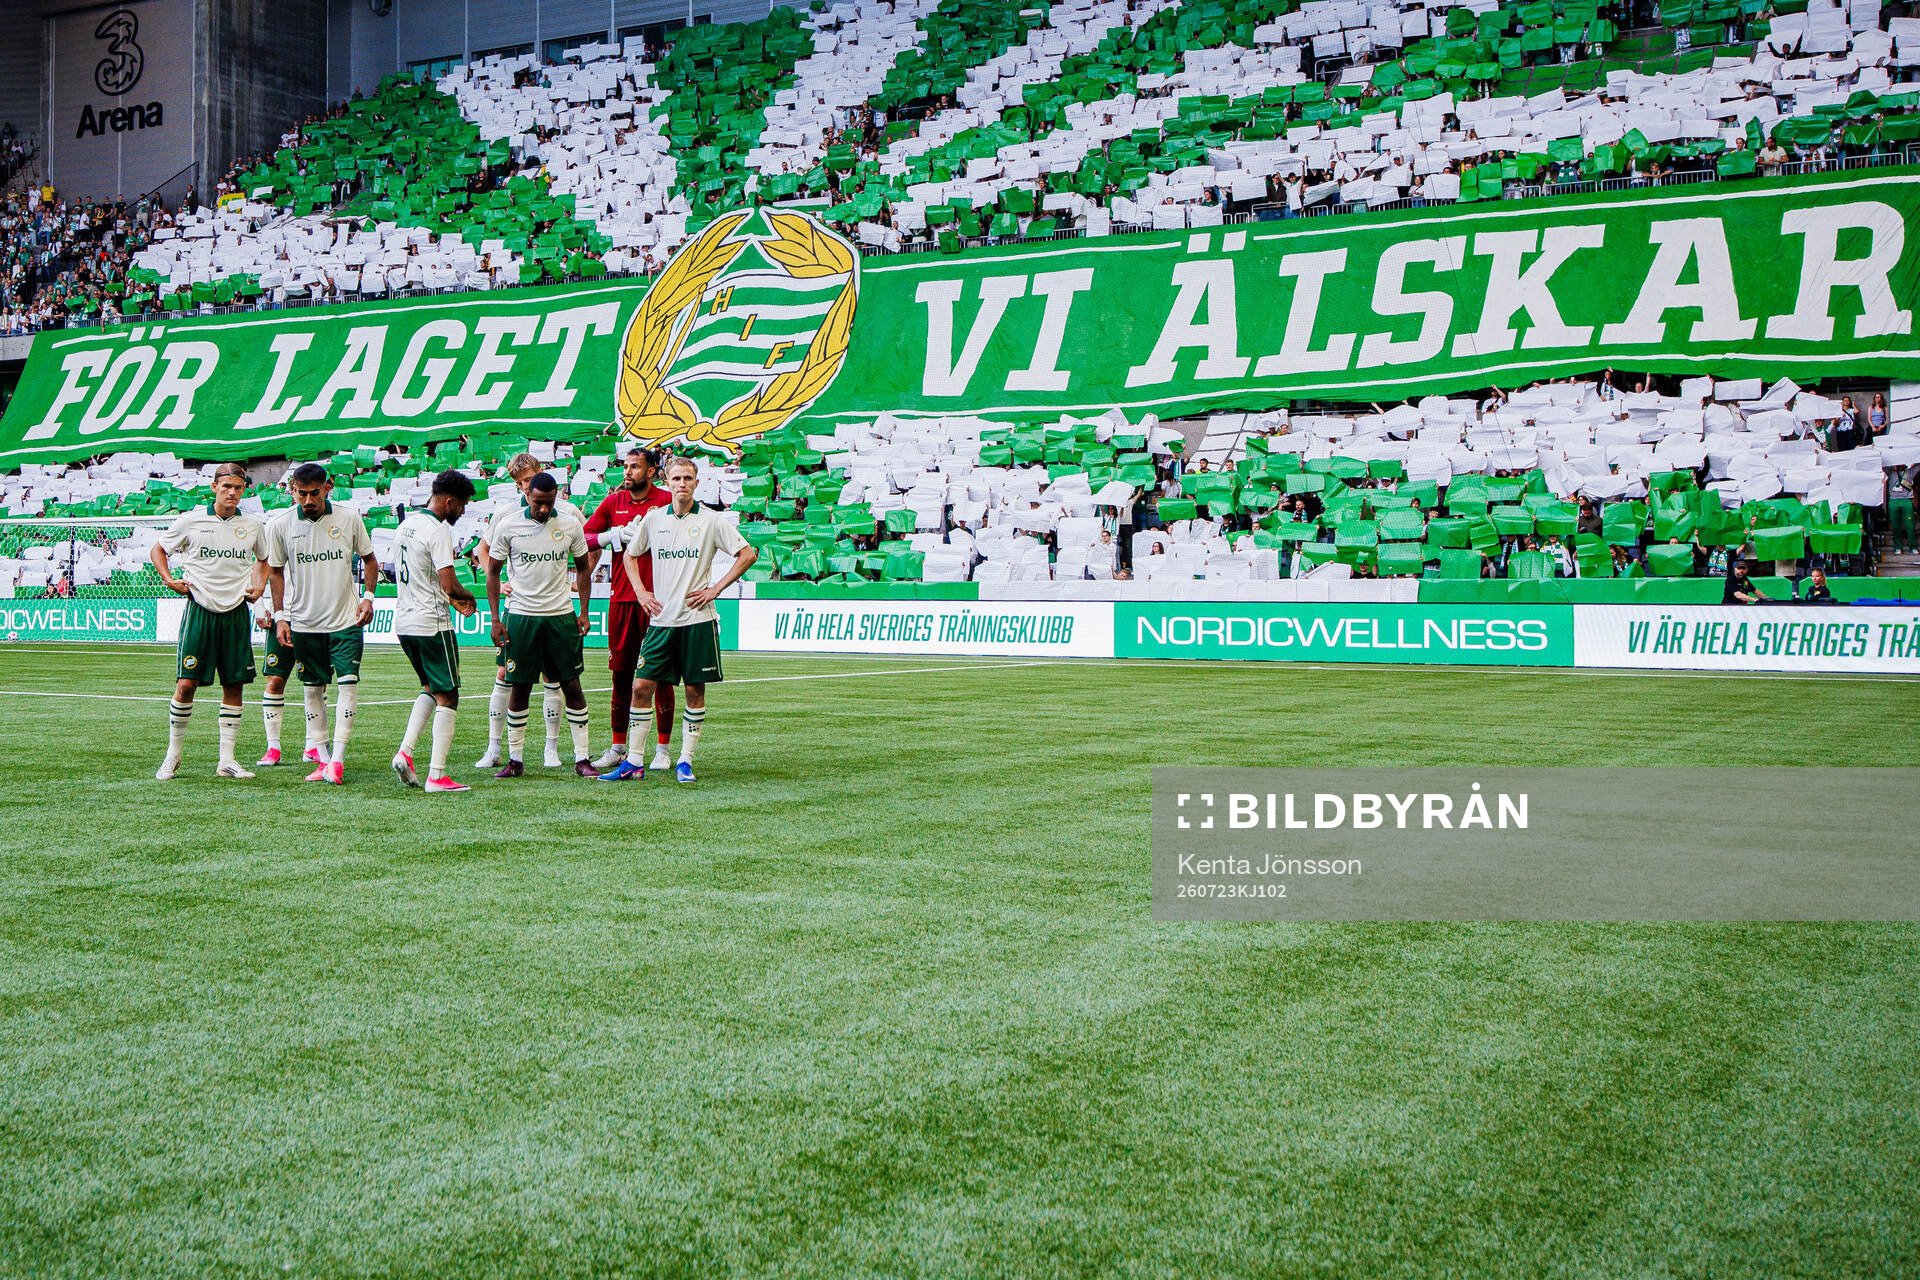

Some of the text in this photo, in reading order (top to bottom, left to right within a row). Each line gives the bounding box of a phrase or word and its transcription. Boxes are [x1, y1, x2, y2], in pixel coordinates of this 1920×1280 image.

[76, 102, 163, 138] Arena
[22, 201, 1912, 441] FÖR LAGET VI ÄLSKAR
[200, 547, 246, 559] Revolut
[297, 549, 343, 564] Revolut
[520, 551, 566, 563] Revolut
[658, 549, 699, 559] Revolut
[775, 608, 1074, 643] VI ÄR HELA SVERIGES TRÄNINGSKLUBB
[1137, 616, 1548, 650] NORDICWELLNESS
[1628, 621, 1650, 653] VI
[1653, 614, 1686, 654] ÄR
[1691, 622, 1748, 655] HELA
[1755, 622, 1869, 656] SVERIGES
